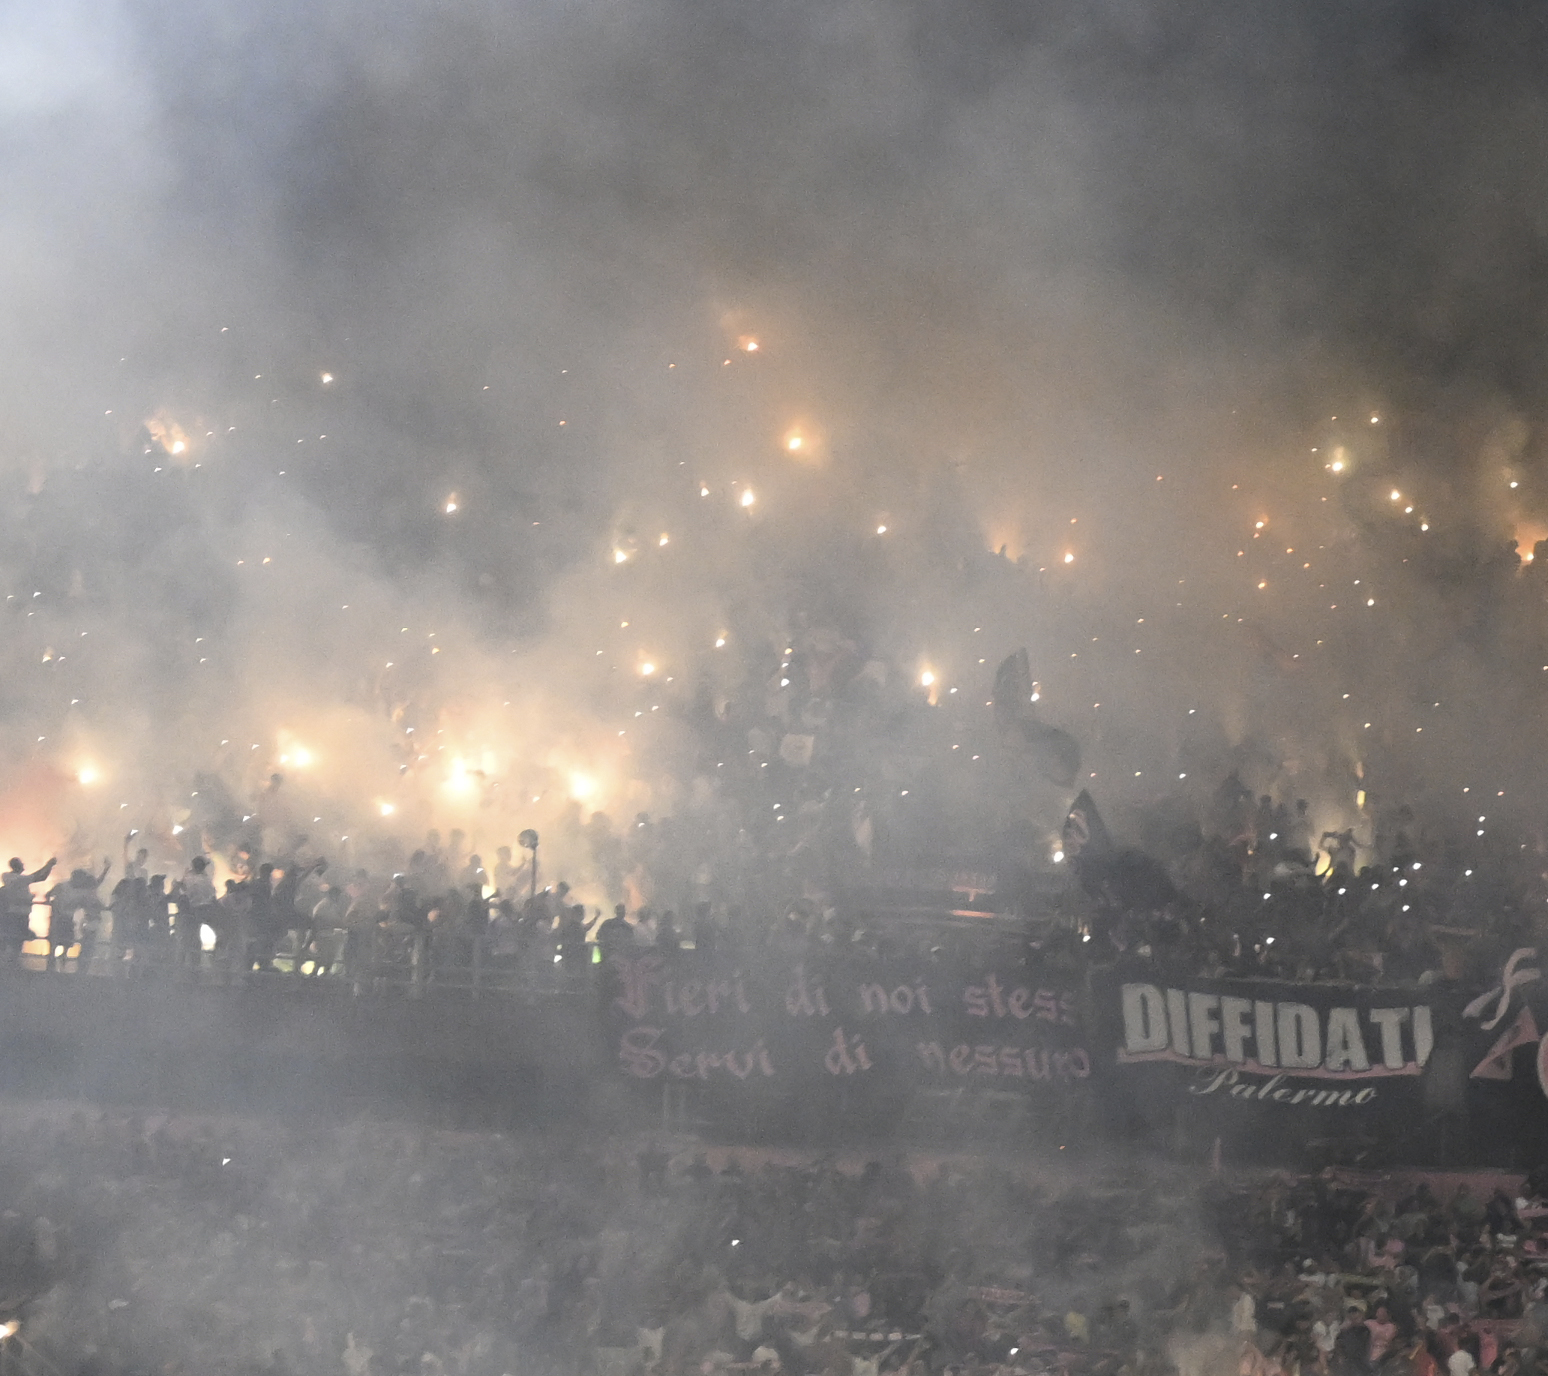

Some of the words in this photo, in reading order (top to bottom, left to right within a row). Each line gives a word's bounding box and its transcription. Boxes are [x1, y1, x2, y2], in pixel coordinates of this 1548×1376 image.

[785, 965, 832, 1017] di
[860, 976, 932, 1015] noi
[618, 1026, 777, 1081] Servi
[824, 1027, 873, 1075] di
[1120, 981, 1435, 1073] DIFFIDATI
[1189, 1067, 1379, 1108] Palermo
